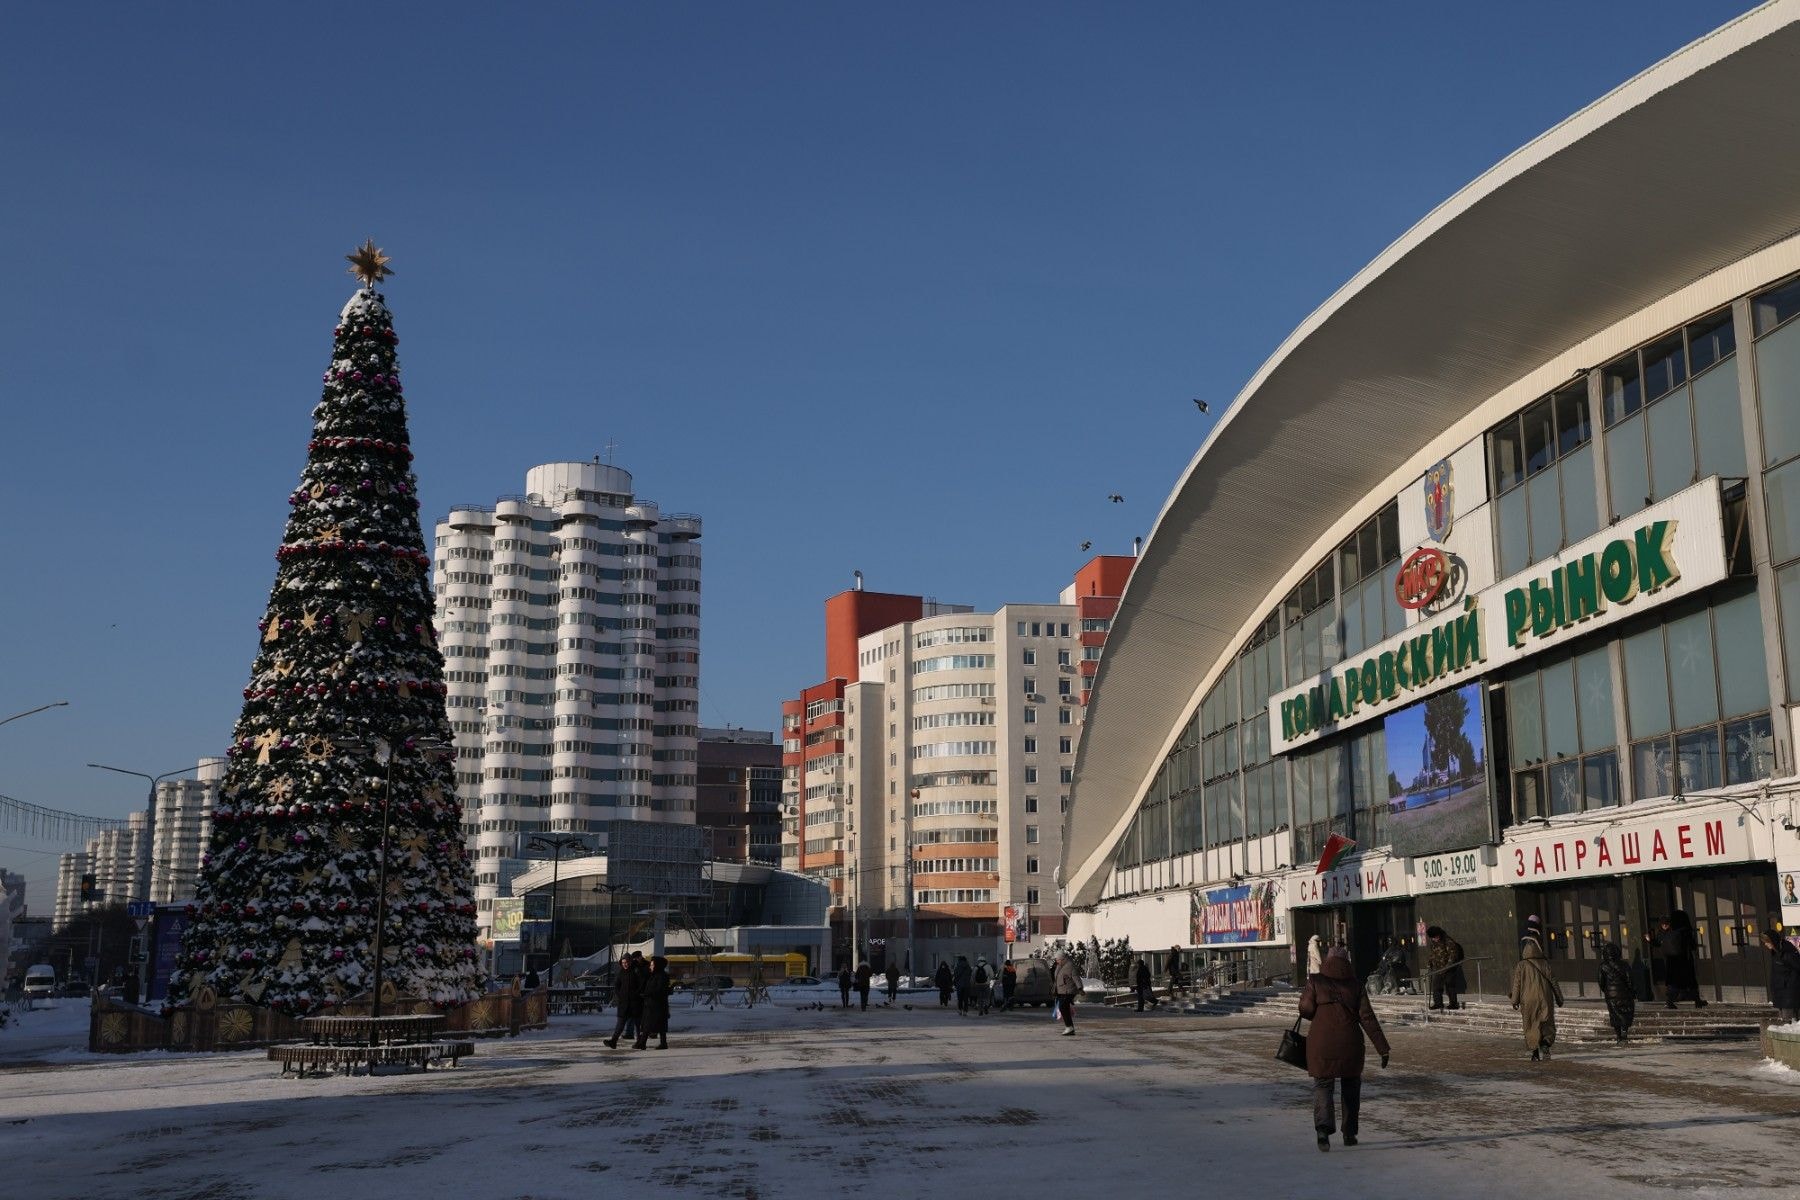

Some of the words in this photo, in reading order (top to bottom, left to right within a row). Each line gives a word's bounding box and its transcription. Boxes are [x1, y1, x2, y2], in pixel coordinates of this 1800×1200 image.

[1403, 557, 1438, 600] МКР
[1281, 595, 1487, 742] КОМАРОВСКИЙ
[1504, 519, 1680, 648] РЫНОК
[1423, 858, 1442, 878] 9.00
[1450, 853, 1476, 875] 19.00
[1514, 819, 1727, 878] ЗАПРАШАЕМ
[1299, 868, 1389, 902] САРДЭЧНА
